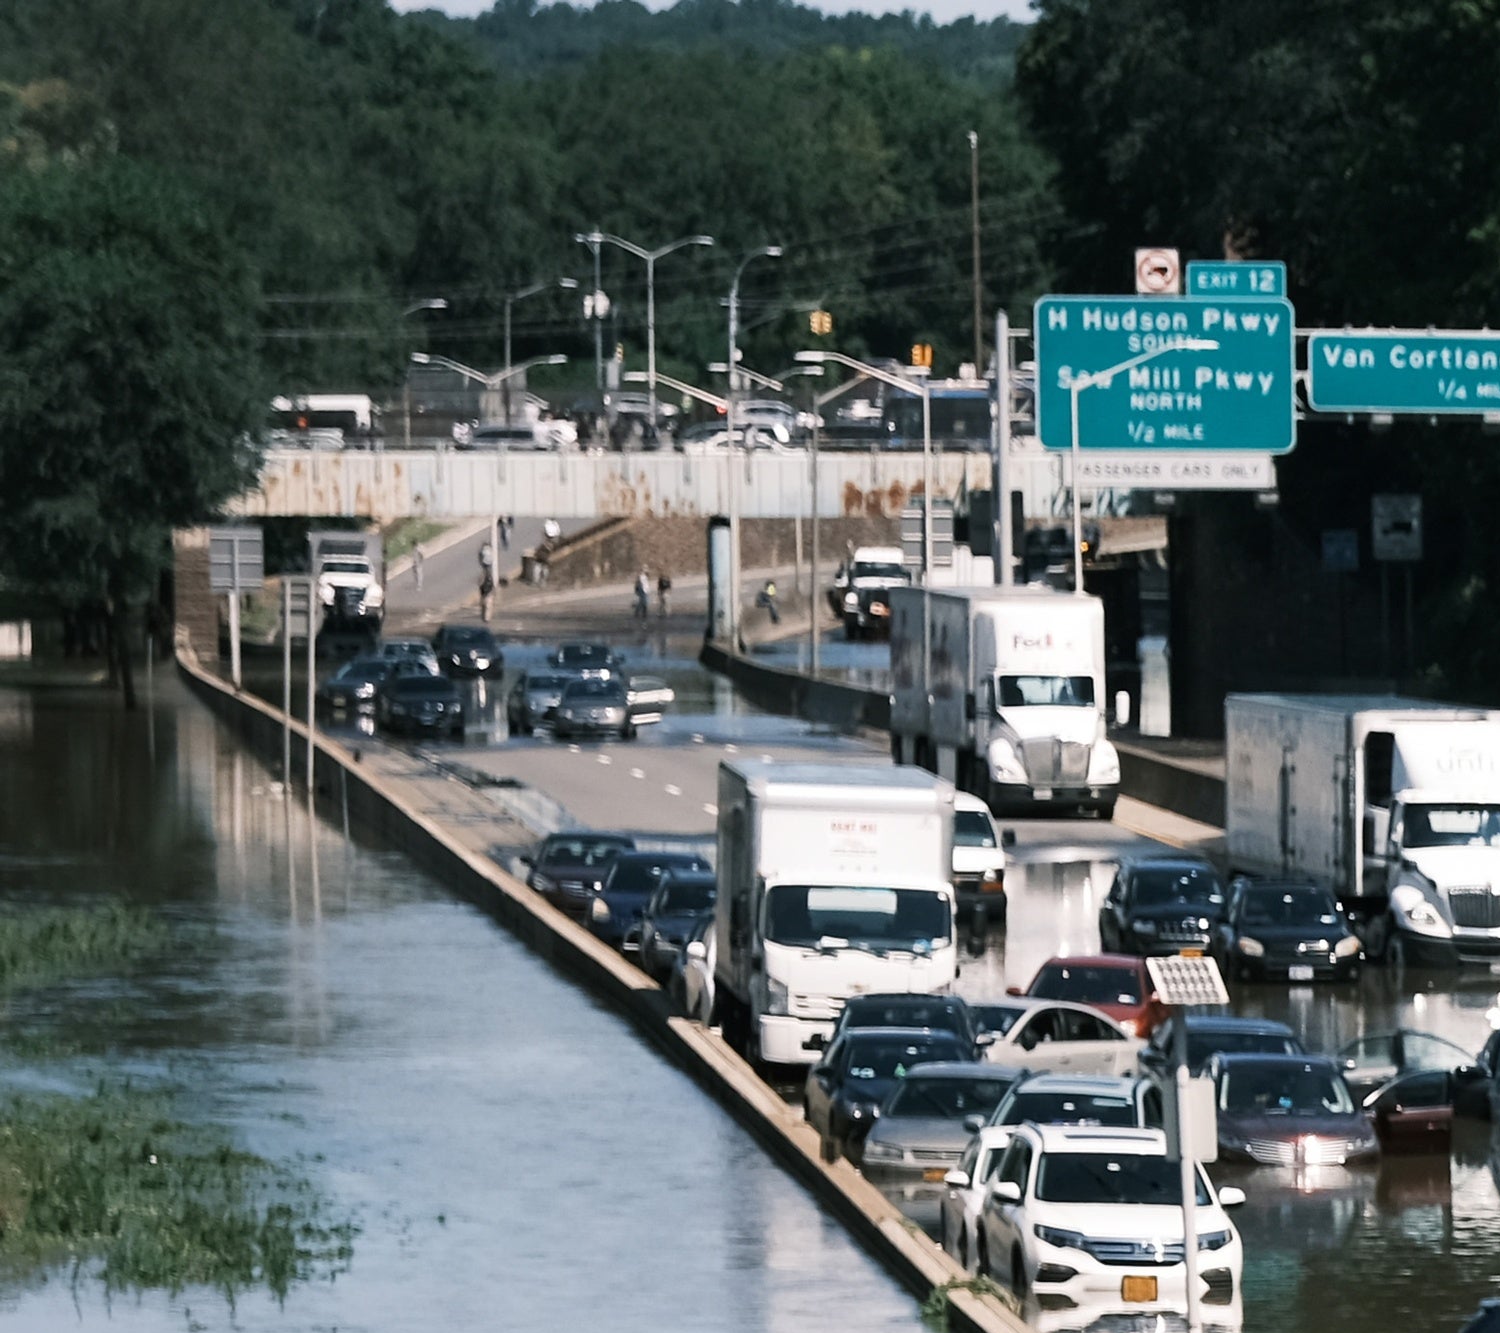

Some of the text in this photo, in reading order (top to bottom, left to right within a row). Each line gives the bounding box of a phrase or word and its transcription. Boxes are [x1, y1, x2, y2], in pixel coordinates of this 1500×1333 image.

[1249, 270, 1276, 292] 12
[1083, 307, 1188, 331] Hudson
[1203, 307, 1280, 336] Pkwy
[1322, 344, 1375, 369] Van
[1129, 366, 1181, 390] Mill
[1195, 366, 1274, 395] Pkwy
[1130, 392, 1202, 411] NORTH
[1163, 423, 1205, 441] MILE
[1077, 463, 1162, 477] ASSENGER
